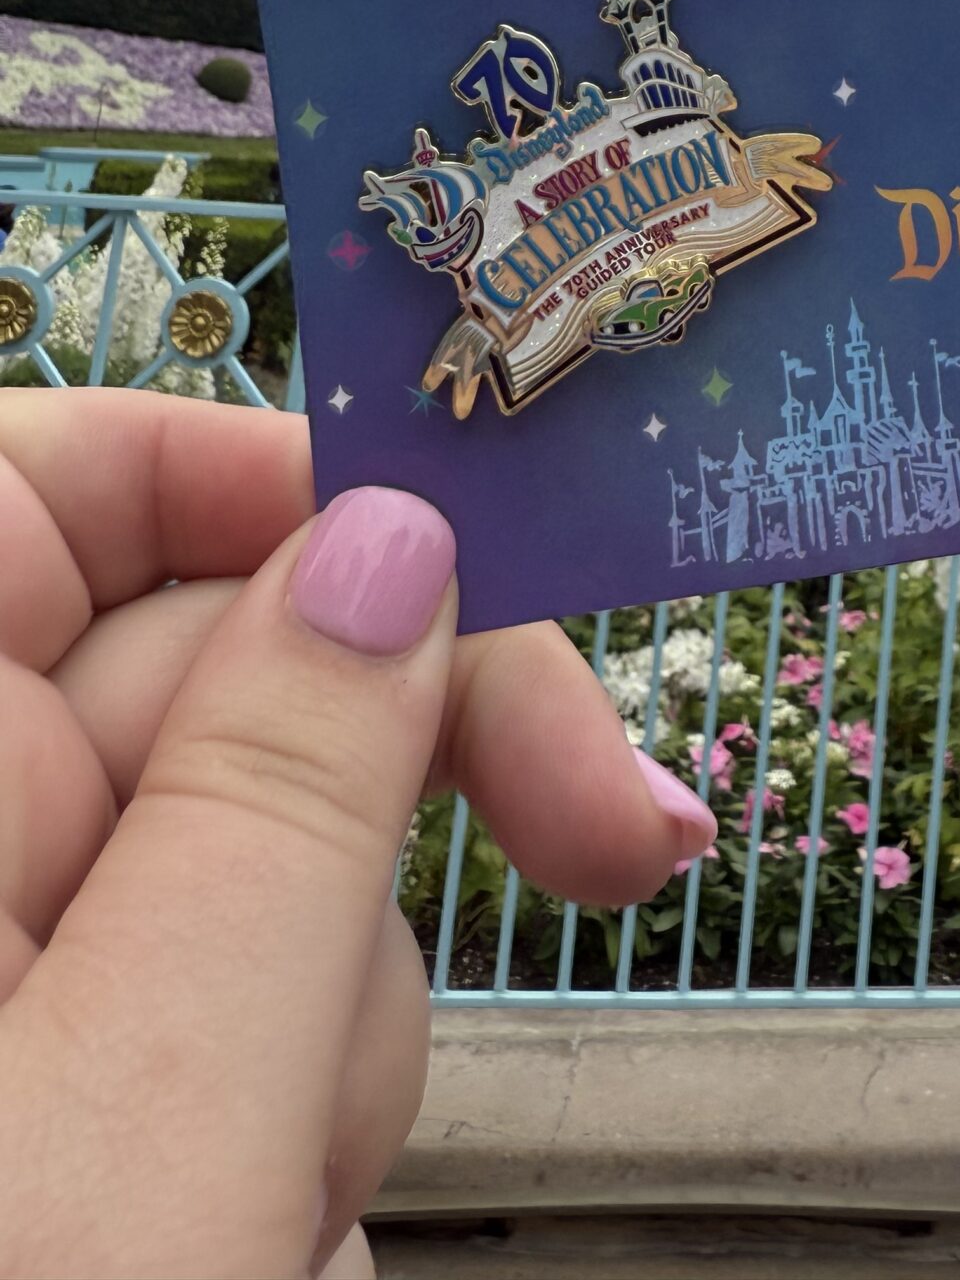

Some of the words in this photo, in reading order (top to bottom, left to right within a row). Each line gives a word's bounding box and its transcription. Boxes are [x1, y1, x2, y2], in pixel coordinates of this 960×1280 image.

[457, 32, 556, 139] 70
[472, 87, 610, 183] Disneyland
[477, 131, 731, 309] CELEBRATION
[514, 199, 543, 229] A
[534, 150, 603, 211] STORY
[604, 138, 632, 170] OF
[532, 291, 563, 321] THE
[562, 259, 603, 295] 70TH
[604, 203, 711, 265] ANNIVERSARY
[575, 255, 632, 300] GUIDED
[636, 230, 677, 262] TOUR
